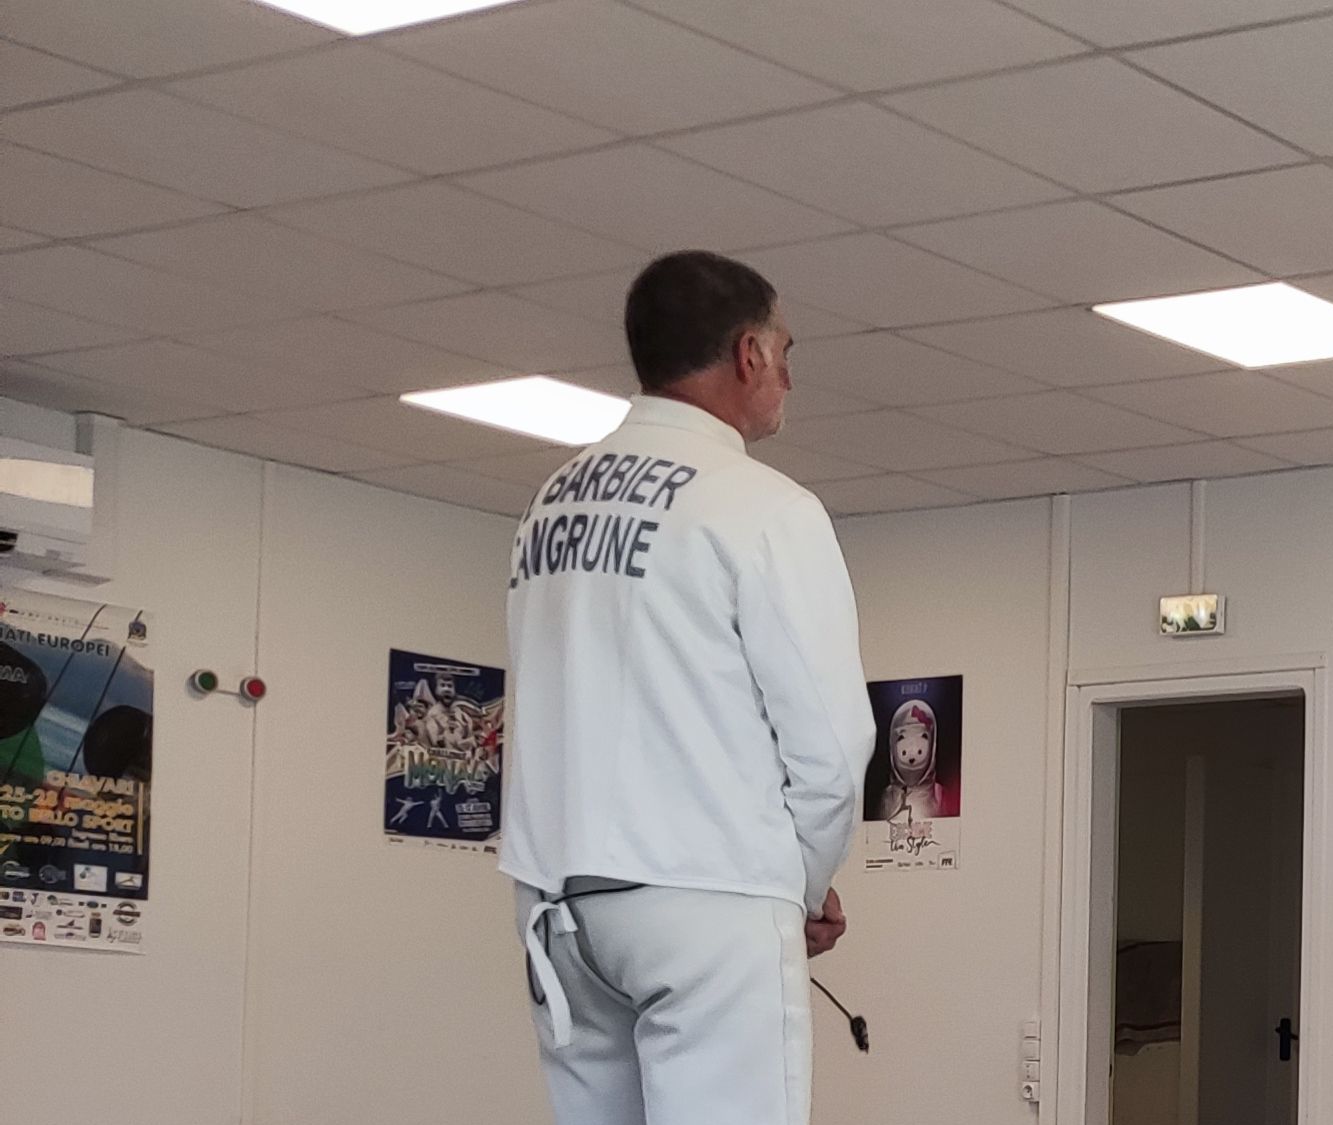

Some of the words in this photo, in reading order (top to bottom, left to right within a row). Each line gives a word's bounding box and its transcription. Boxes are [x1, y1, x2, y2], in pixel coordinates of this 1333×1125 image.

[543, 454, 698, 511] BARBIER
[0, 626, 31, 643] ATI
[37, 633, 110, 657] EUROPEI
